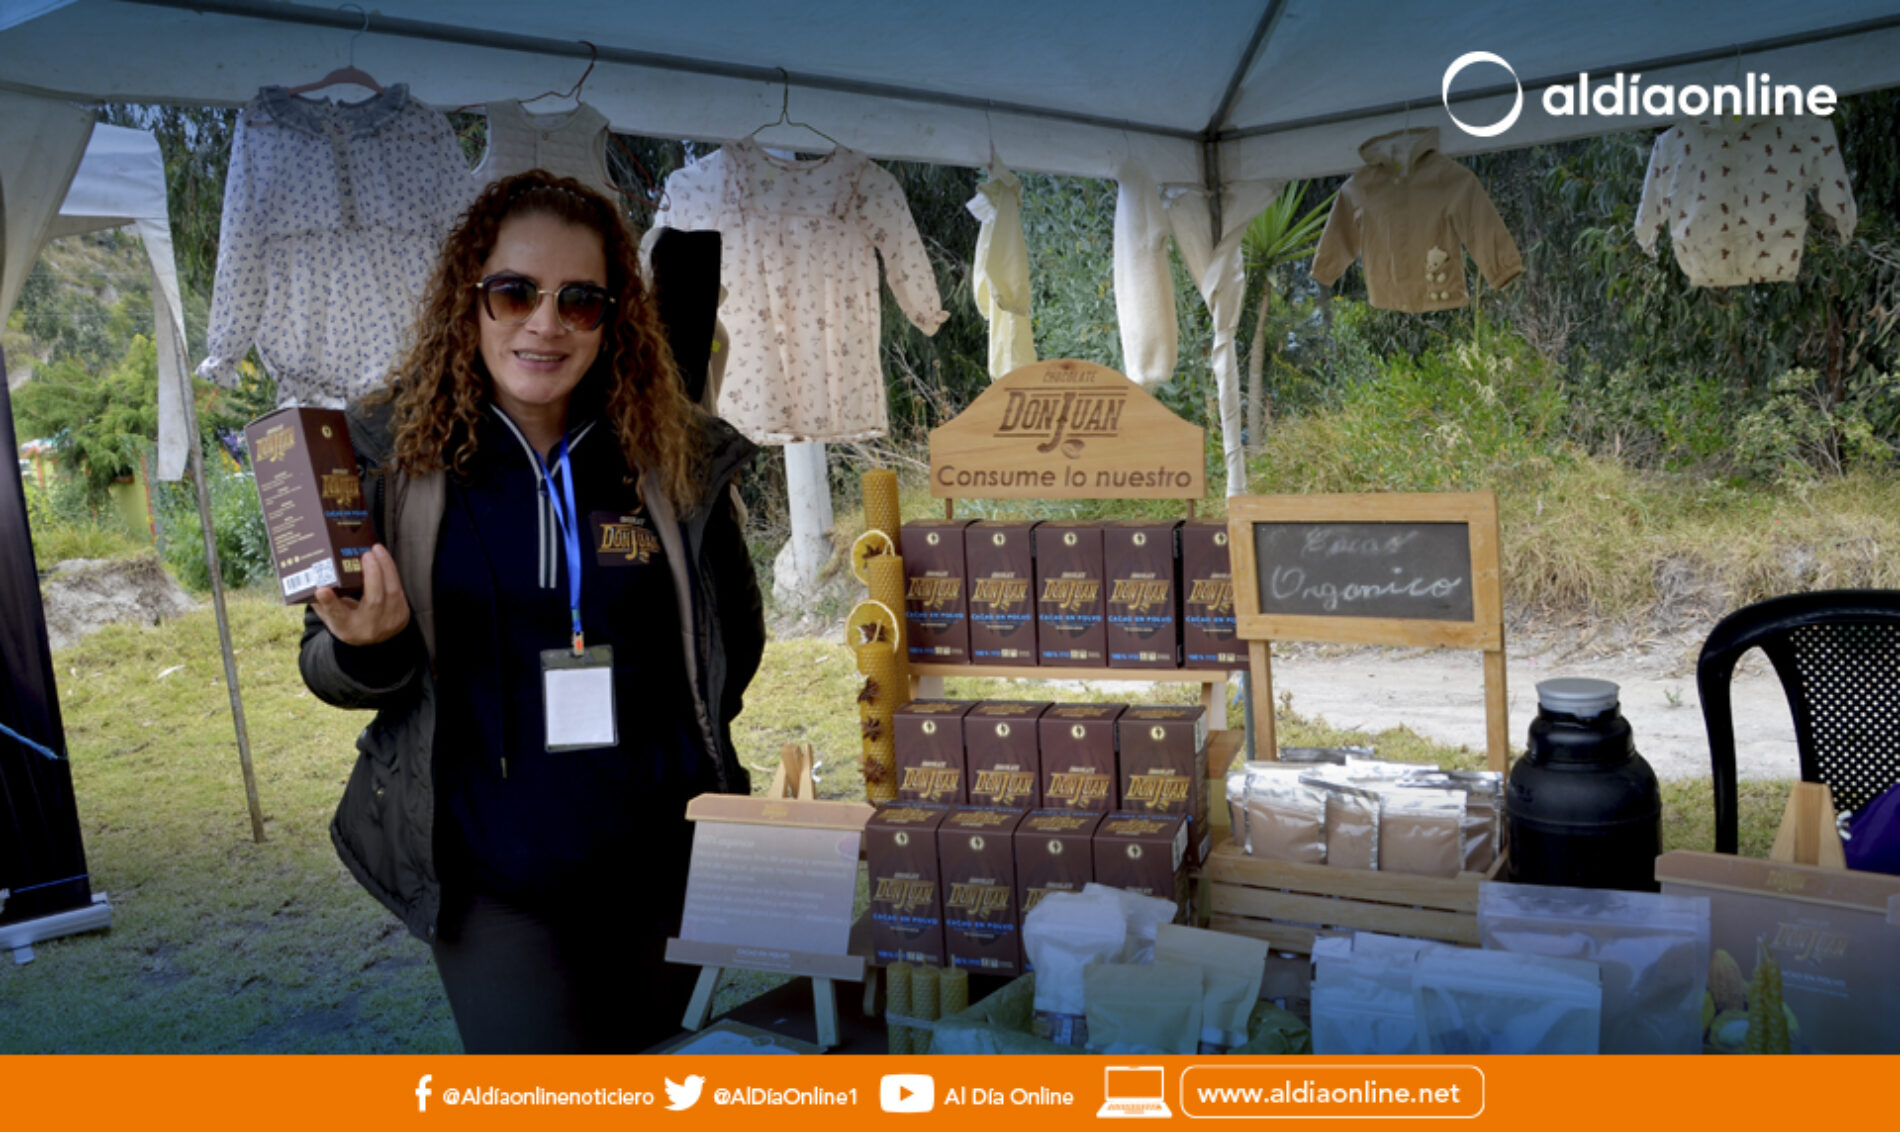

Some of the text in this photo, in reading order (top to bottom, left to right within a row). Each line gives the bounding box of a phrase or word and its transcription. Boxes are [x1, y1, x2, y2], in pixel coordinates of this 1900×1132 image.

[1042, 370, 1098, 383] CHOCOLATE
[936, 465, 1193, 488] Consume lo nuestro
[1271, 564, 1463, 612] Organico
